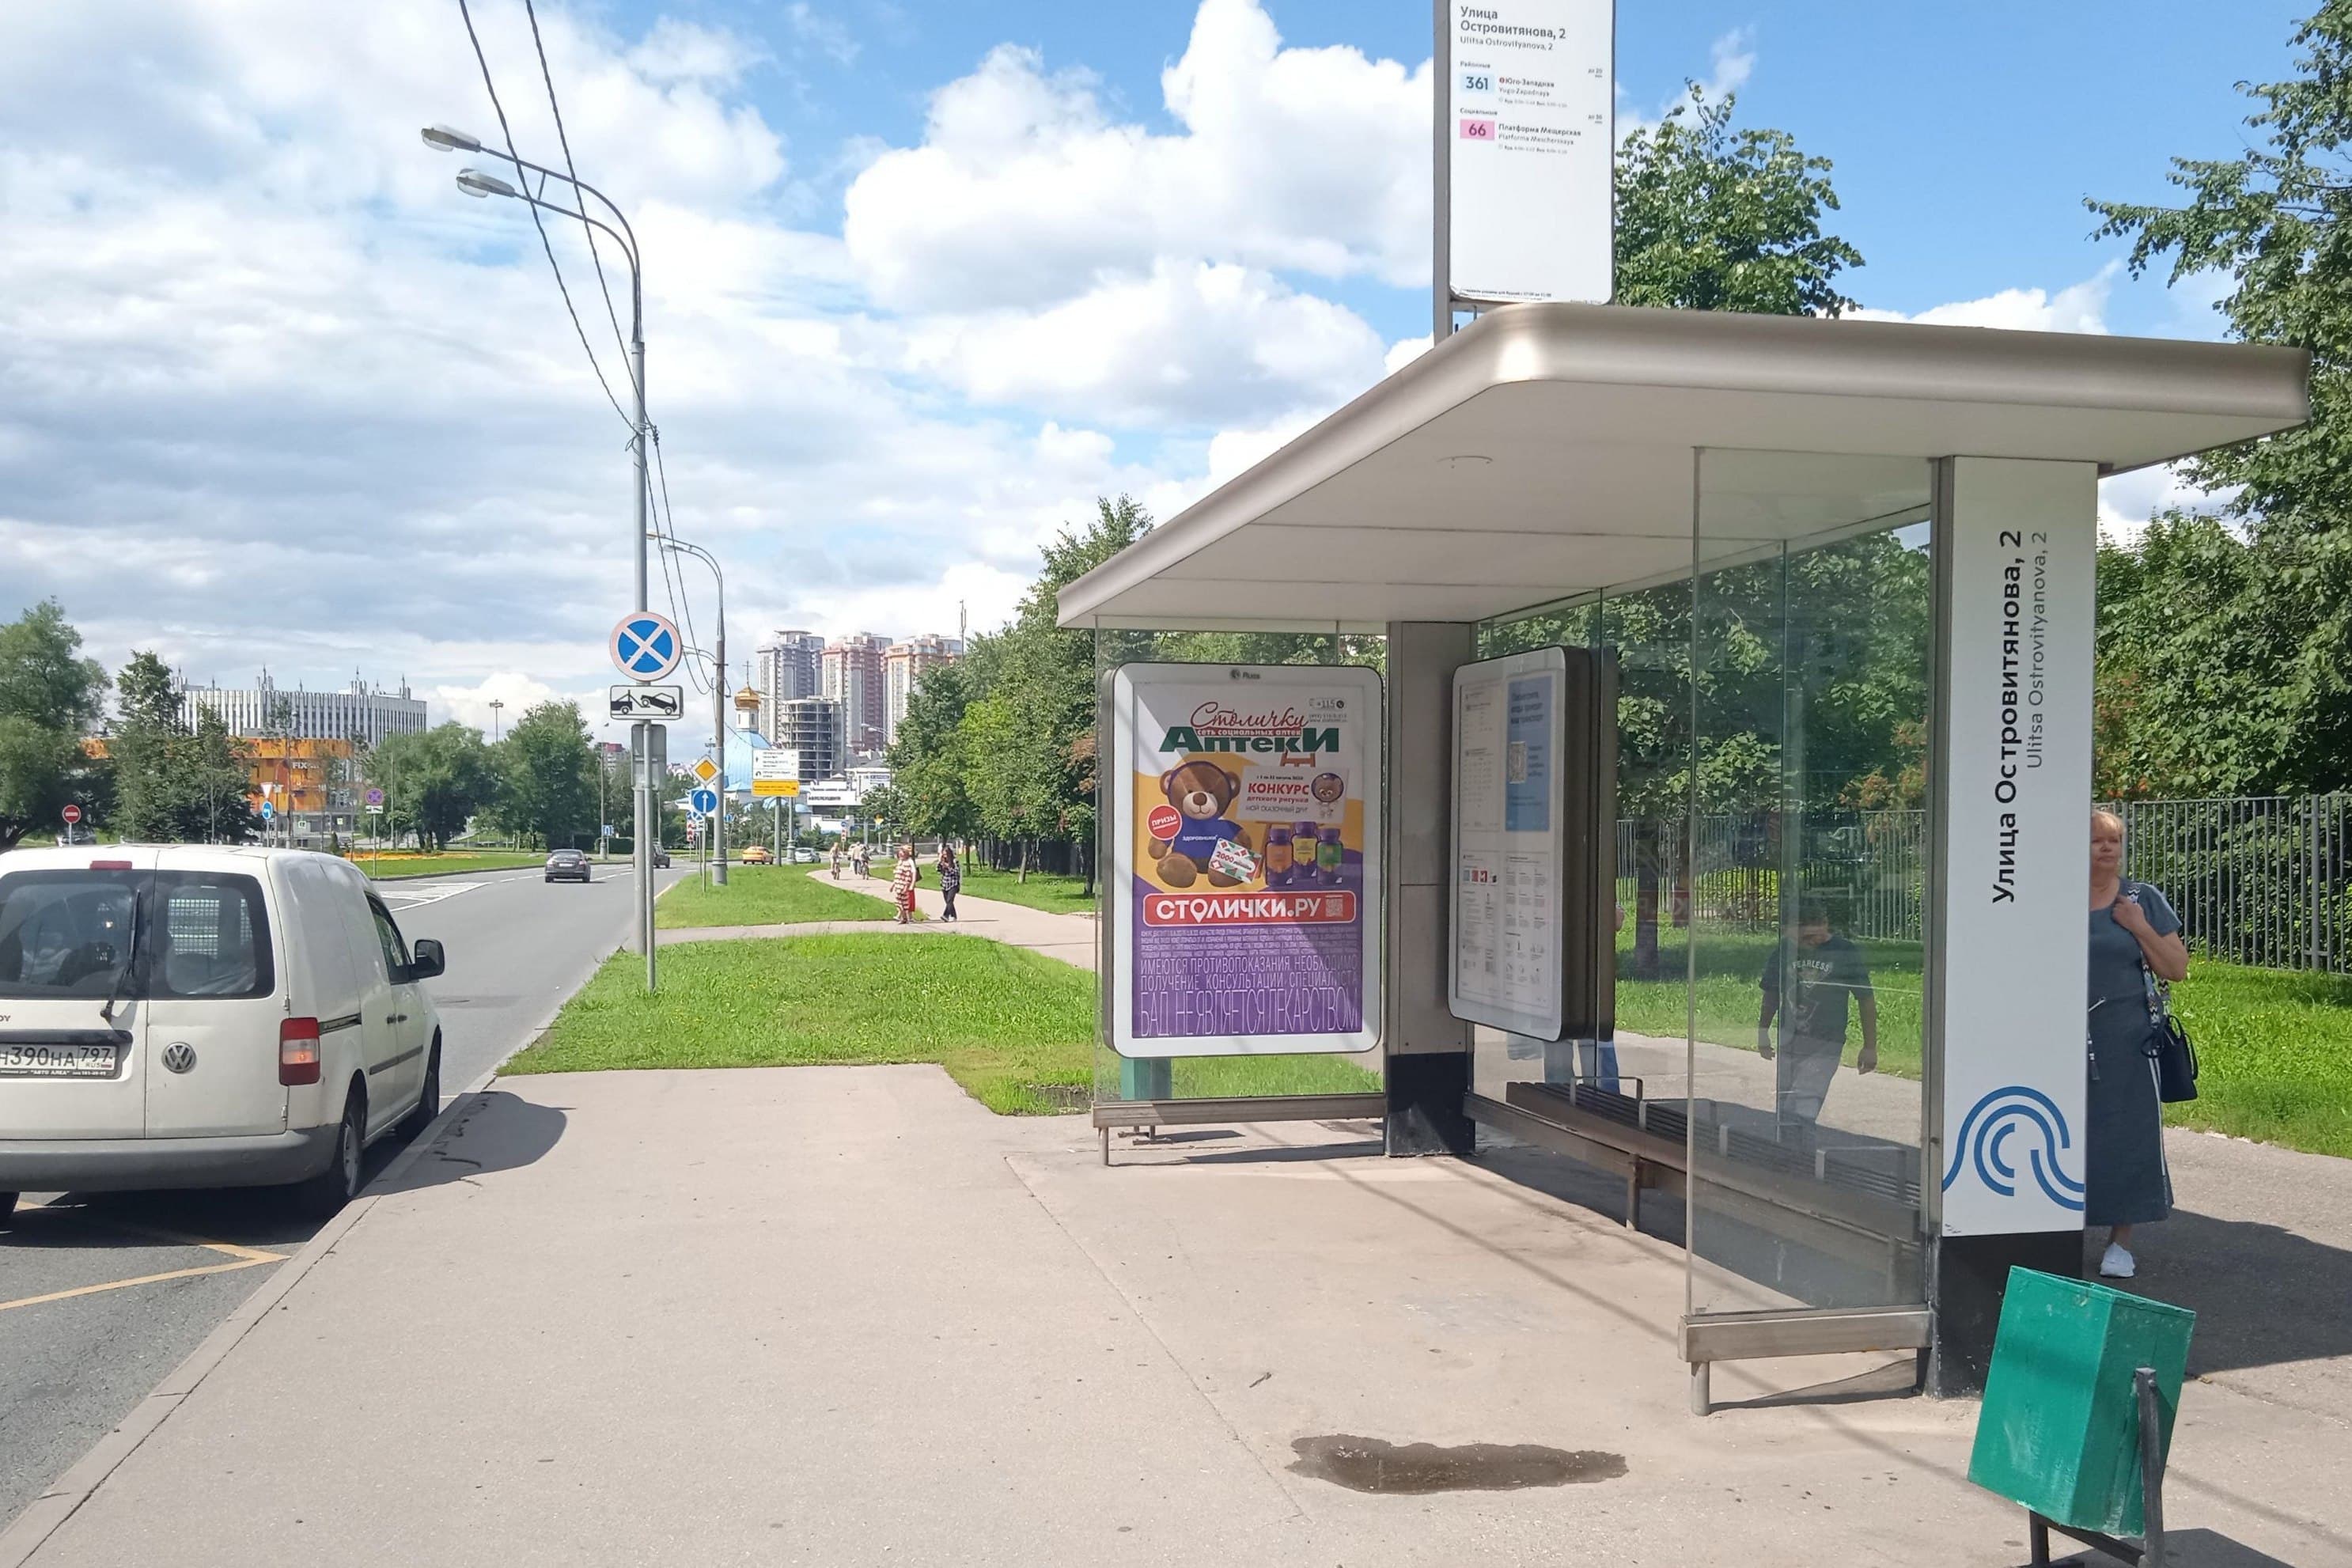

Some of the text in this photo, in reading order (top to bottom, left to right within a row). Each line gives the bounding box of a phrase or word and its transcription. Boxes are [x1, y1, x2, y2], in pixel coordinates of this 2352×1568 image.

[1460, 6, 1498, 21] Улица
[1460, 20, 1566, 40] Островитянова, 2
[1460, 36, 1484, 45] Ulitsa
[1486, 38, 1547, 51] Ostrovityanova,
[1466, 77, 1488, 90] 361
[1468, 123, 1487, 136] 66
[2027, 532, 2049, 768] Ulitsa Ostrovityanova, 2
[1190, 701, 1309, 728] Столички
[1992, 530, 2025, 903] Улица Островитянова, 2
[1248, 782, 1310, 795] КОНКУРС
[1151, 815, 1177, 827] ПРИЗЫ
[1216, 850, 1234, 863] 2000
[1156, 897, 1322, 923] СТОЛИЧКИ.РУ
[1141, 958, 1187, 975] ИМЕЮТСЯ
[1190, 956, 1290, 974] ПРОТИВОПОКАЗАНИЯ
[1792, 959, 1830, 973] FEARLESS
[1141, 970, 1358, 991] ПОЛУЧЕНИЕ КОНСУЛЬТАЦИИ СПЕЦИАЛИСТА
[1176, 990, 1194, 1035] НЕ
[1195, 989, 1264, 1035] ЯВЛЯЕТСЯ
[1267, 987, 1358, 1032] ЛЕКАРСТВОМ
[81, 1047, 111, 1062] 797
